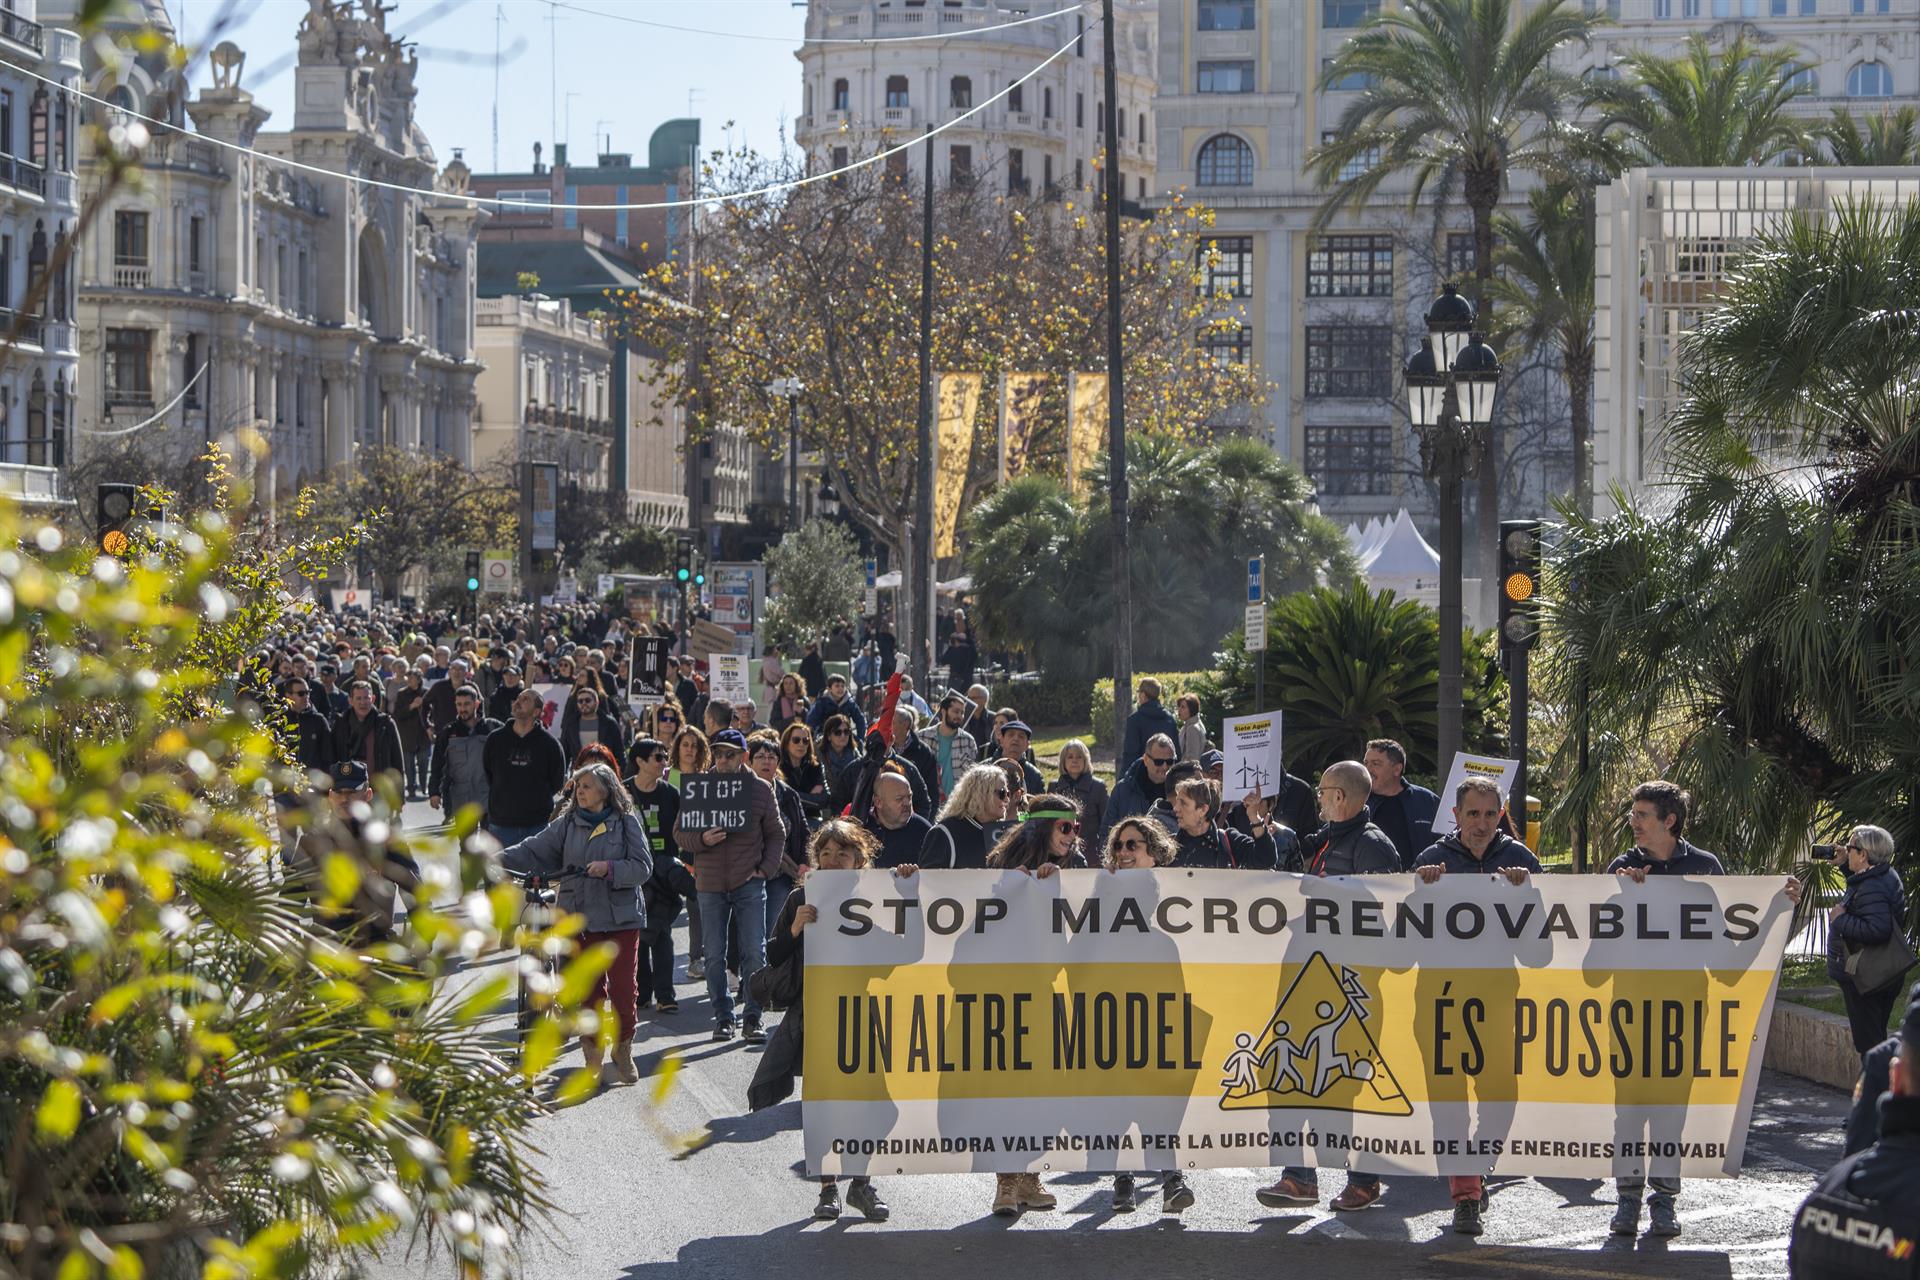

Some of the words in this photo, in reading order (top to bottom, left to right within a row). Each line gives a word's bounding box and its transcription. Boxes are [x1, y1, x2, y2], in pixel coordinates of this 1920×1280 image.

[1483, 766, 1504, 774] Aguas
[685, 780, 742, 799] STOP
[682, 809, 746, 828] MOLINOS
[838, 897, 1008, 937] STOP
[837, 995, 892, 1075] UN
[907, 992, 1033, 1073] ALTRE
[1053, 991, 1202, 1070] MODEL
[1434, 980, 1485, 1077] ÉS
[1514, 998, 1741, 1079] POSSIBLE
[832, 1136, 996, 1156] COORDINADORA
[1001, 1134, 1134, 1152] VALENCIANA
[1141, 1134, 1181, 1150] PER
[1188, 1134, 1213, 1150] LA
[1220, 1127, 1319, 1149] UBICACIÓ
[1325, 1132, 1426, 1155] RACIONAL
[1432, 1139, 1460, 1156] DE
[1465, 1139, 1504, 1156] LES
[1511, 1140, 1615, 1159] ENERGIES
